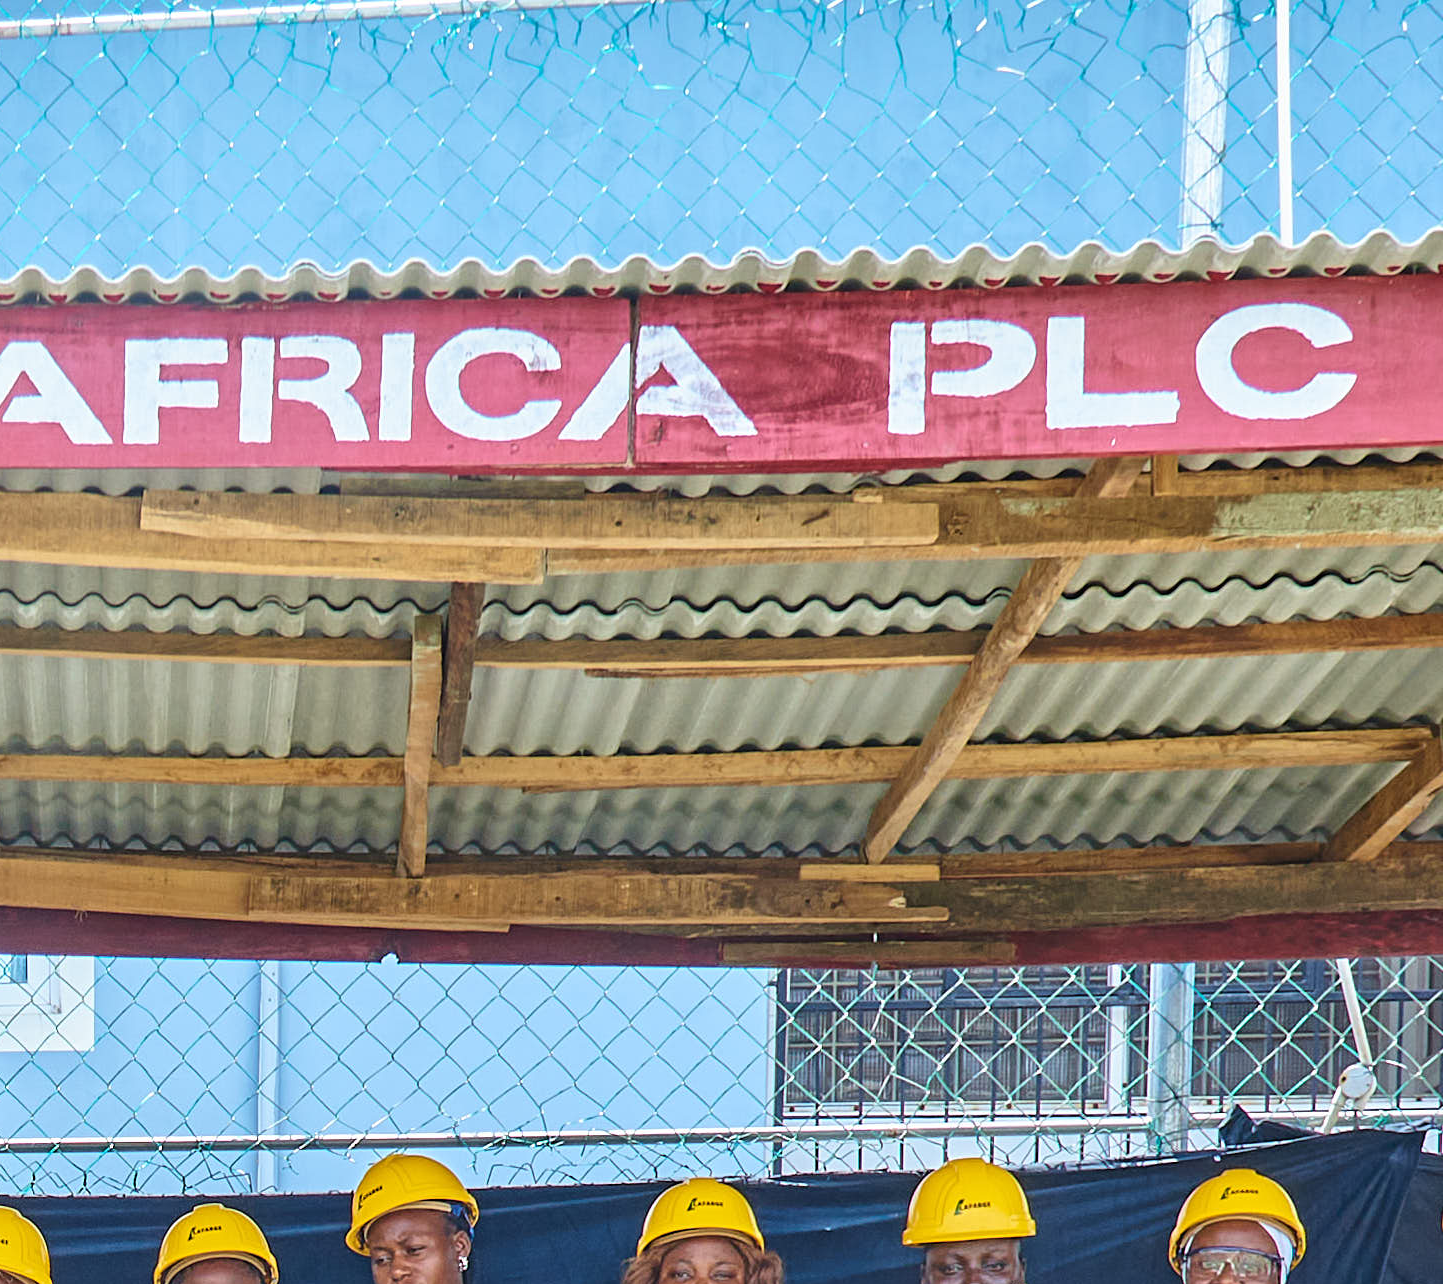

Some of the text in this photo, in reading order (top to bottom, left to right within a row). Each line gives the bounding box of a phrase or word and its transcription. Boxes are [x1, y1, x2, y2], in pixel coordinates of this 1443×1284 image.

[887, 302, 1357, 435] PLC
[1220, 1186, 1259, 1201] LAFARGE
[686, 1197, 724, 1212] LAFARGE
[187, 1225, 222, 1242] LAFARGE
